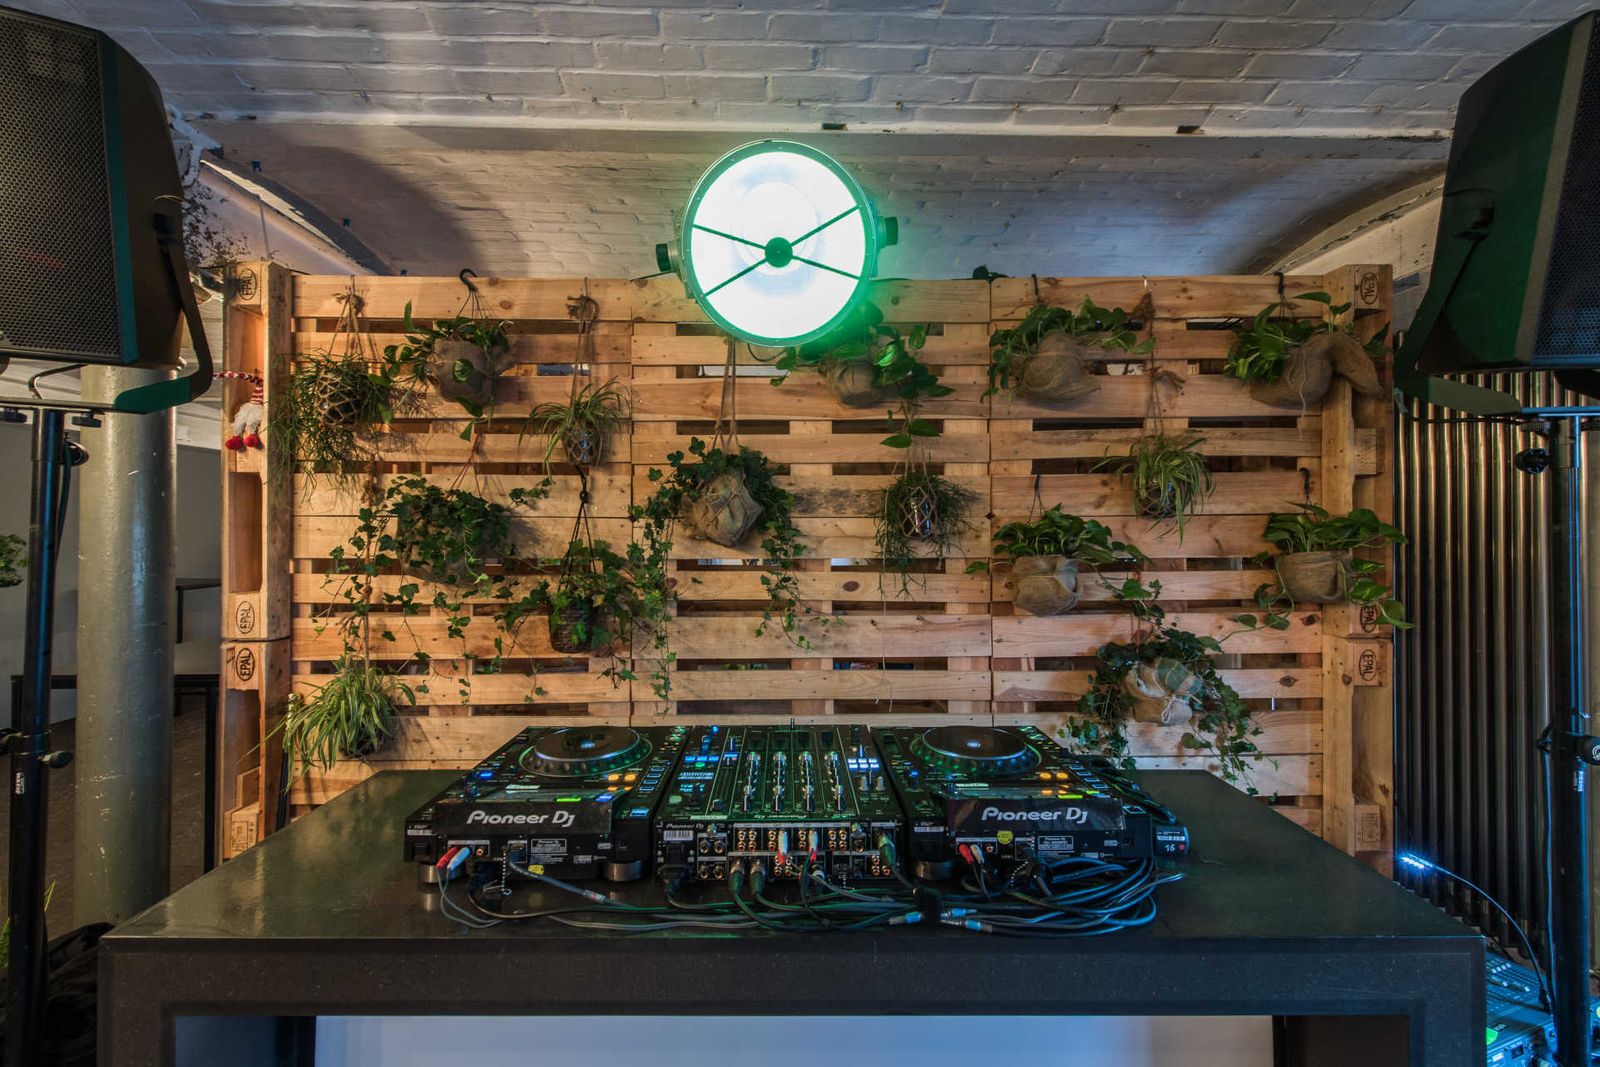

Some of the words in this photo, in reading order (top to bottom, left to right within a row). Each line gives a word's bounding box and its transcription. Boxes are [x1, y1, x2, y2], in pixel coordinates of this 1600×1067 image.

[1363, 604, 1375, 627] EPAL
[240, 652, 252, 677] EPAL
[1363, 654, 1374, 675] EPAL
[467, 810, 549, 824] Pioneer
[981, 807, 1062, 821] Pioneer
[1164, 843, 1176, 852] 16
